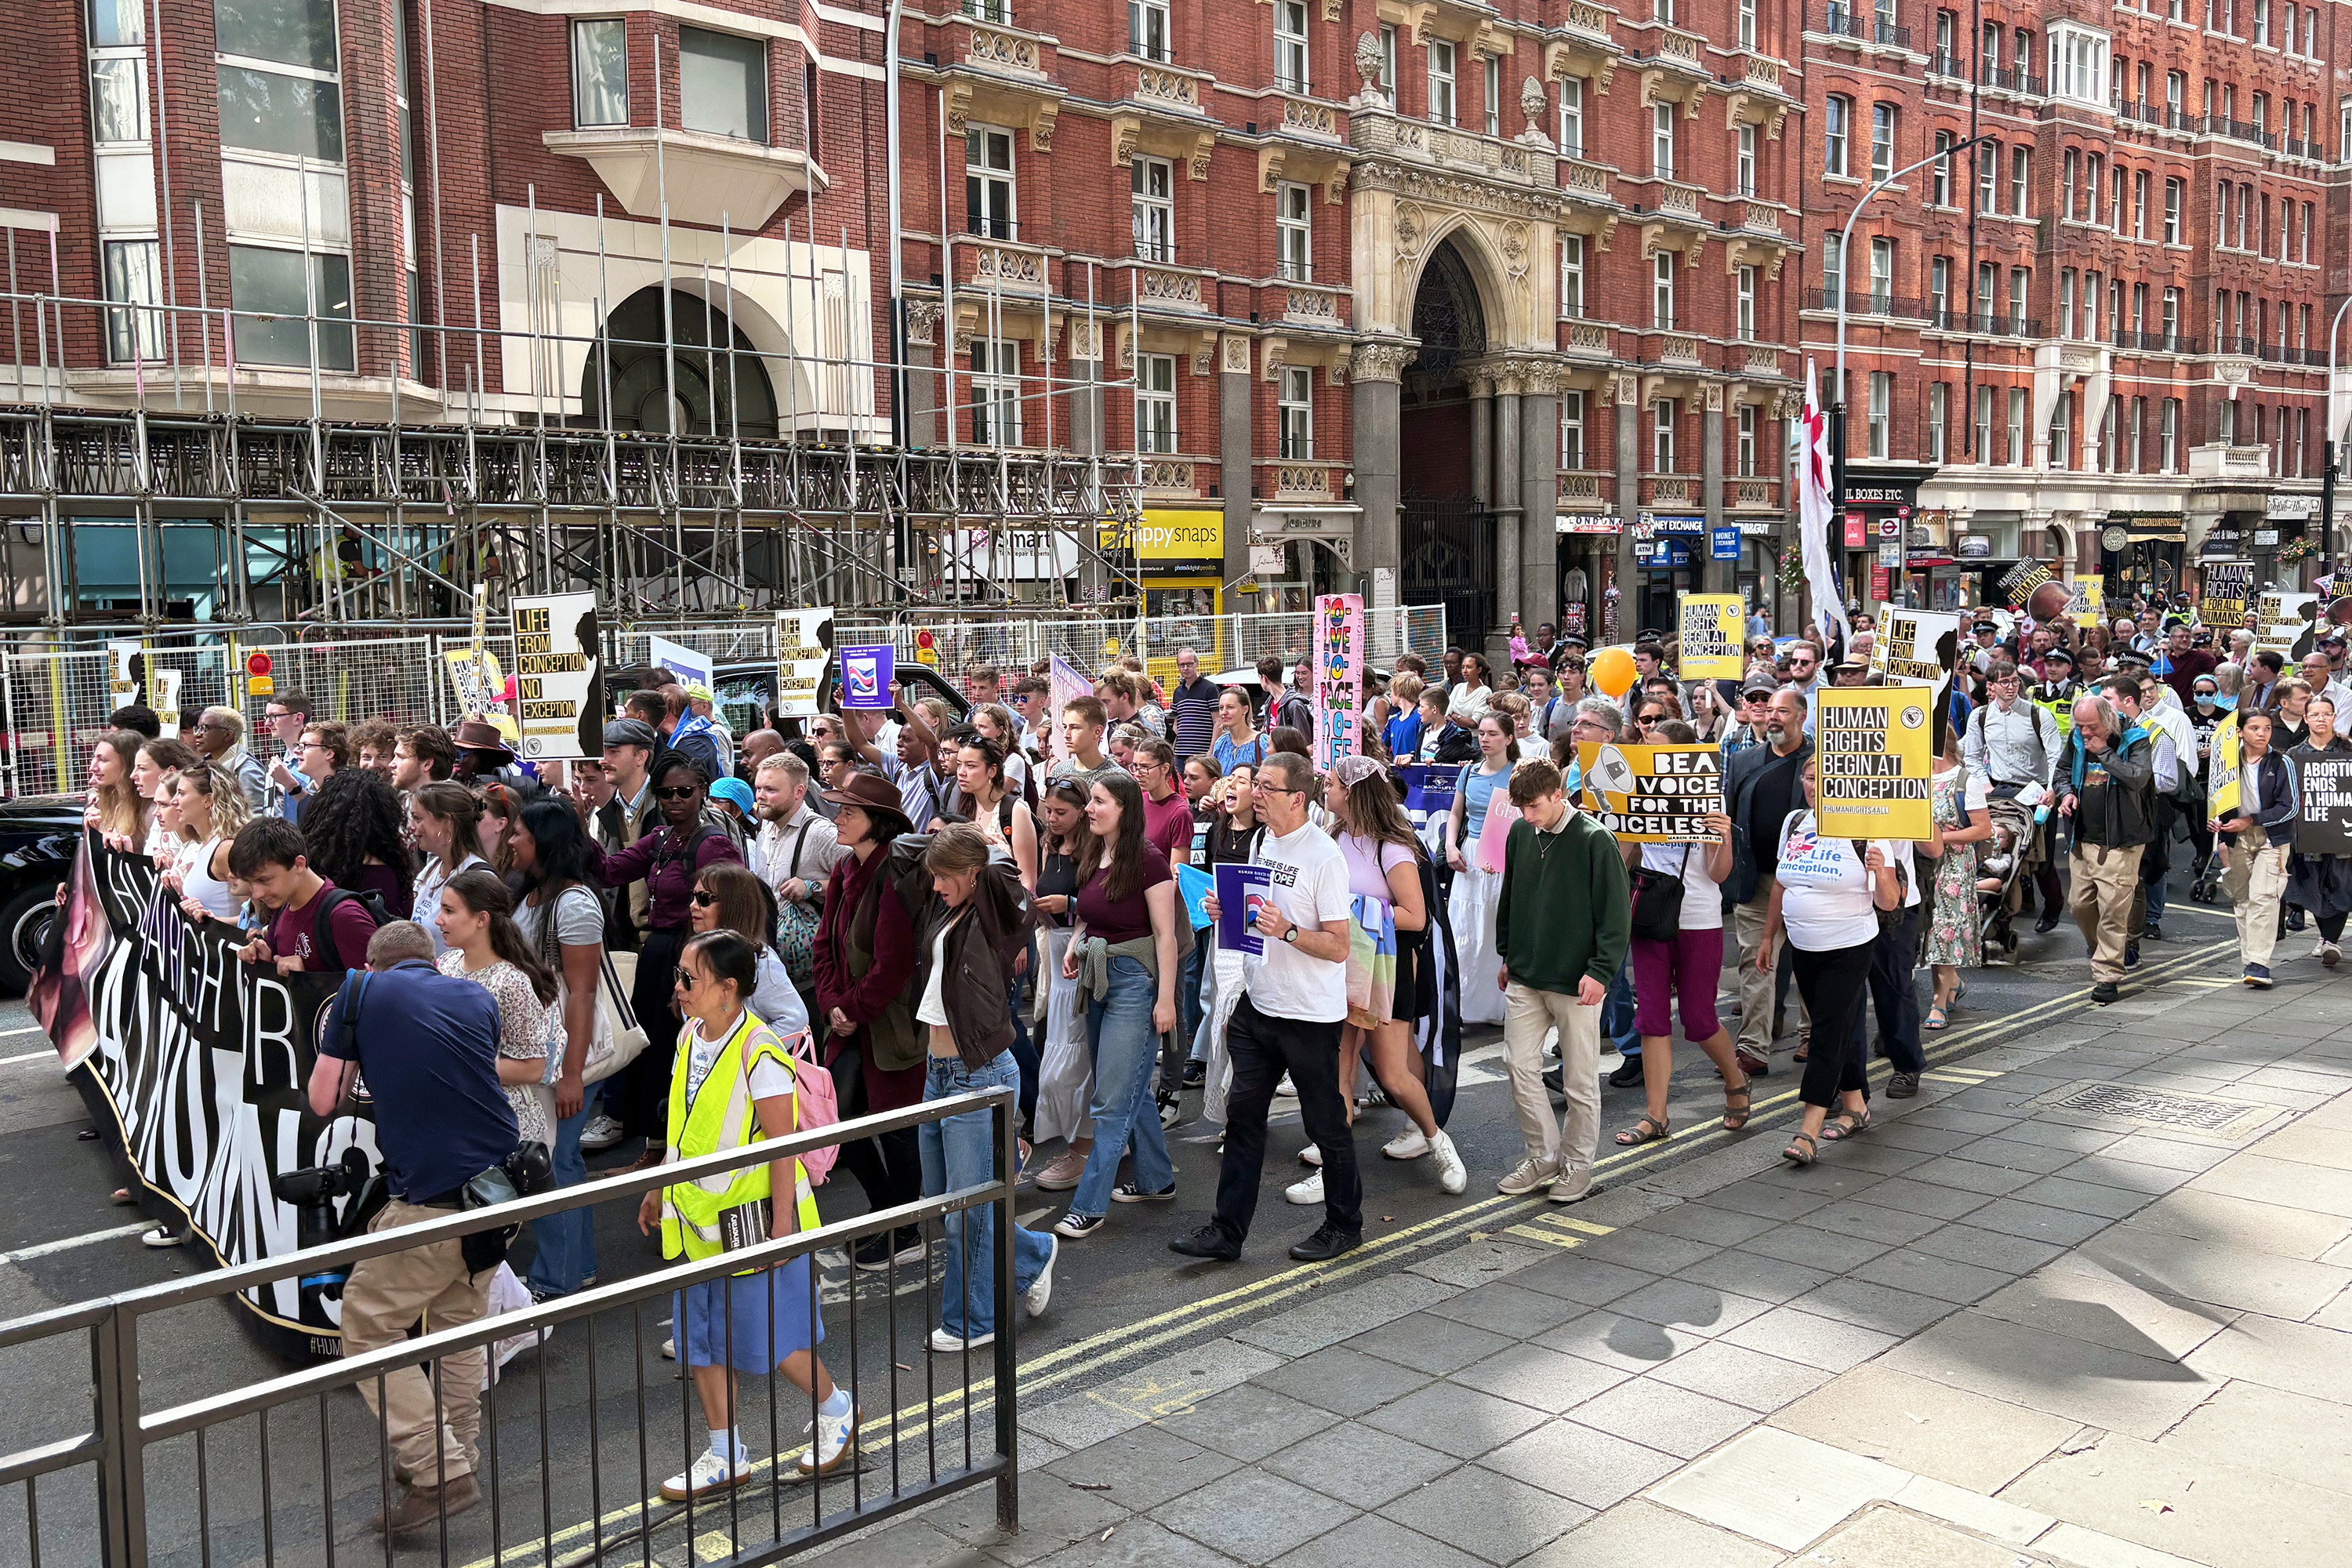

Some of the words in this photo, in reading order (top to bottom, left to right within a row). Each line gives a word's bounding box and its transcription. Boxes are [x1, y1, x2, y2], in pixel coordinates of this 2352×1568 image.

[1845, 488, 1853, 500] IL
[1855, 488, 1883, 500] BOXES
[1885, 489, 1904, 500] ETC.
[1283, 514, 1322, 531] Jasmine
[1653, 521, 1668, 531] NEY
[1669, 521, 1703, 531] EXCHANGE
[2226, 530, 2239, 539] Wine
[2209, 565, 2246, 582] HUMAN
[2009, 575, 2025, 589] FOR
[2009, 567, 2051, 604] HUMANS
[2205, 581, 2245, 600] RIGHTS
[2208, 598, 2223, 610] FOR
[2225, 600, 2238, 611] ALL
[2263, 598, 2281, 608] LIFE
[1683, 604, 1719, 618] HUMAN
[2202, 611, 2242, 625] HUMANS
[515, 608, 549, 633] LIFE
[779, 618, 800, 633] LIFE
[1683, 617, 1717, 630] RIGHTS
[2259, 616, 2303, 626] CONCEPTION
[1682, 631, 1710, 644] BEGIN
[1712, 631, 1726, 642] AT
[1893, 619, 1916, 641] LIFE
[517, 634, 550, 654] FROM
[779, 635, 800, 648] FROM
[780, 647, 824, 661] CONCEPTION
[1682, 644, 1740, 657] CONCEPTION
[1890, 641, 1915, 659] FROM
[518, 652, 586, 674] CONCEPTION
[781, 664, 794, 677] NO
[1888, 659, 1941, 681] CONCEPTION
[781, 679, 816, 690] EXCEPTION
[1054, 661, 1085, 697] ABORTION
[521, 678, 541, 699] NO
[522, 701, 575, 719] EXCEPTION
[1823, 706, 1888, 728] HUMAN
[1823, 731, 1885, 753] RIGHTS
[1655, 753, 1690, 774] BE
[1693, 753, 1717, 773] A
[1823, 753, 1872, 775] BEGIN
[1877, 755, 1901, 775] AT
[2303, 762, 2352, 777] ABORTI
[1639, 776, 1720, 795] VOICE
[1824, 778, 1928, 799] CONCEPTION
[2303, 778, 2337, 792] ENDS
[1630, 797, 1669, 813] FOR
[1680, 797, 1720, 813] THE
[2304, 792, 2314, 807] A
[1823, 805, 1889, 814] #HUMANRIGHTS4ALL
[2304, 807, 2328, 822] LIFE
[1810, 849, 1842, 862] Life
[1283, 863, 1300, 875] LIFE
[1778, 862, 1842, 877] conception,
[1274, 872, 1294, 886] OPE
